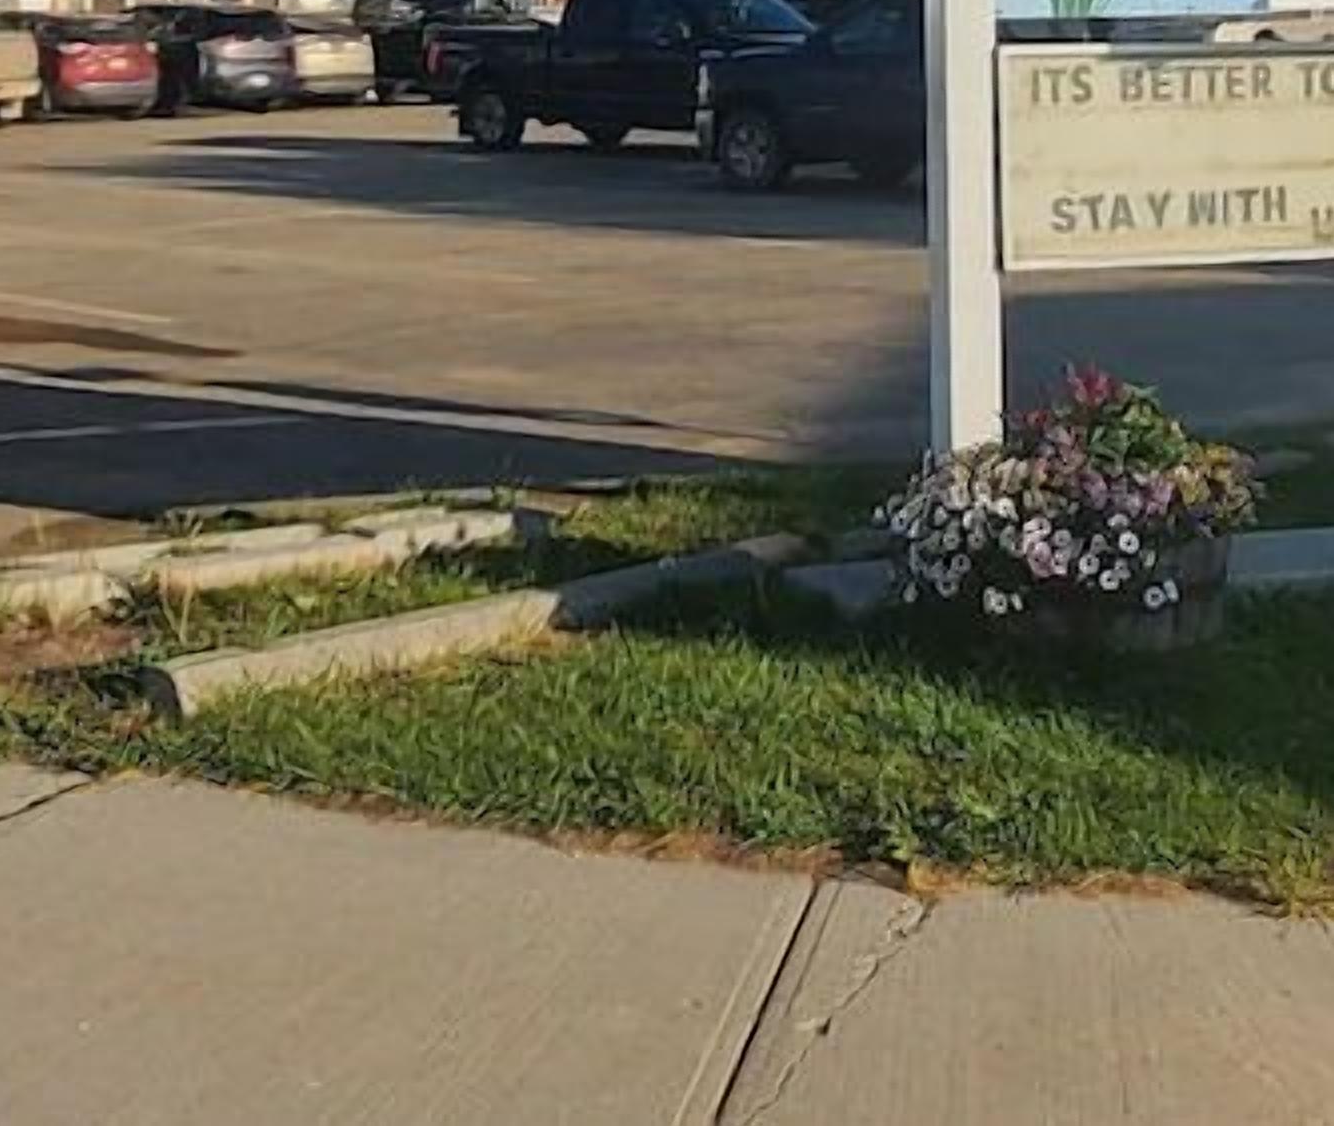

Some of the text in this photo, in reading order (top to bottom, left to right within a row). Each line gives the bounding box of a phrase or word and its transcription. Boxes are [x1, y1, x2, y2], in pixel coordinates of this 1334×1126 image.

[1030, 65, 1094, 104] ITS
[1118, 63, 1273, 102] BETTER
[1051, 189, 1171, 234] STAY
[1188, 186, 1288, 226] WITH
